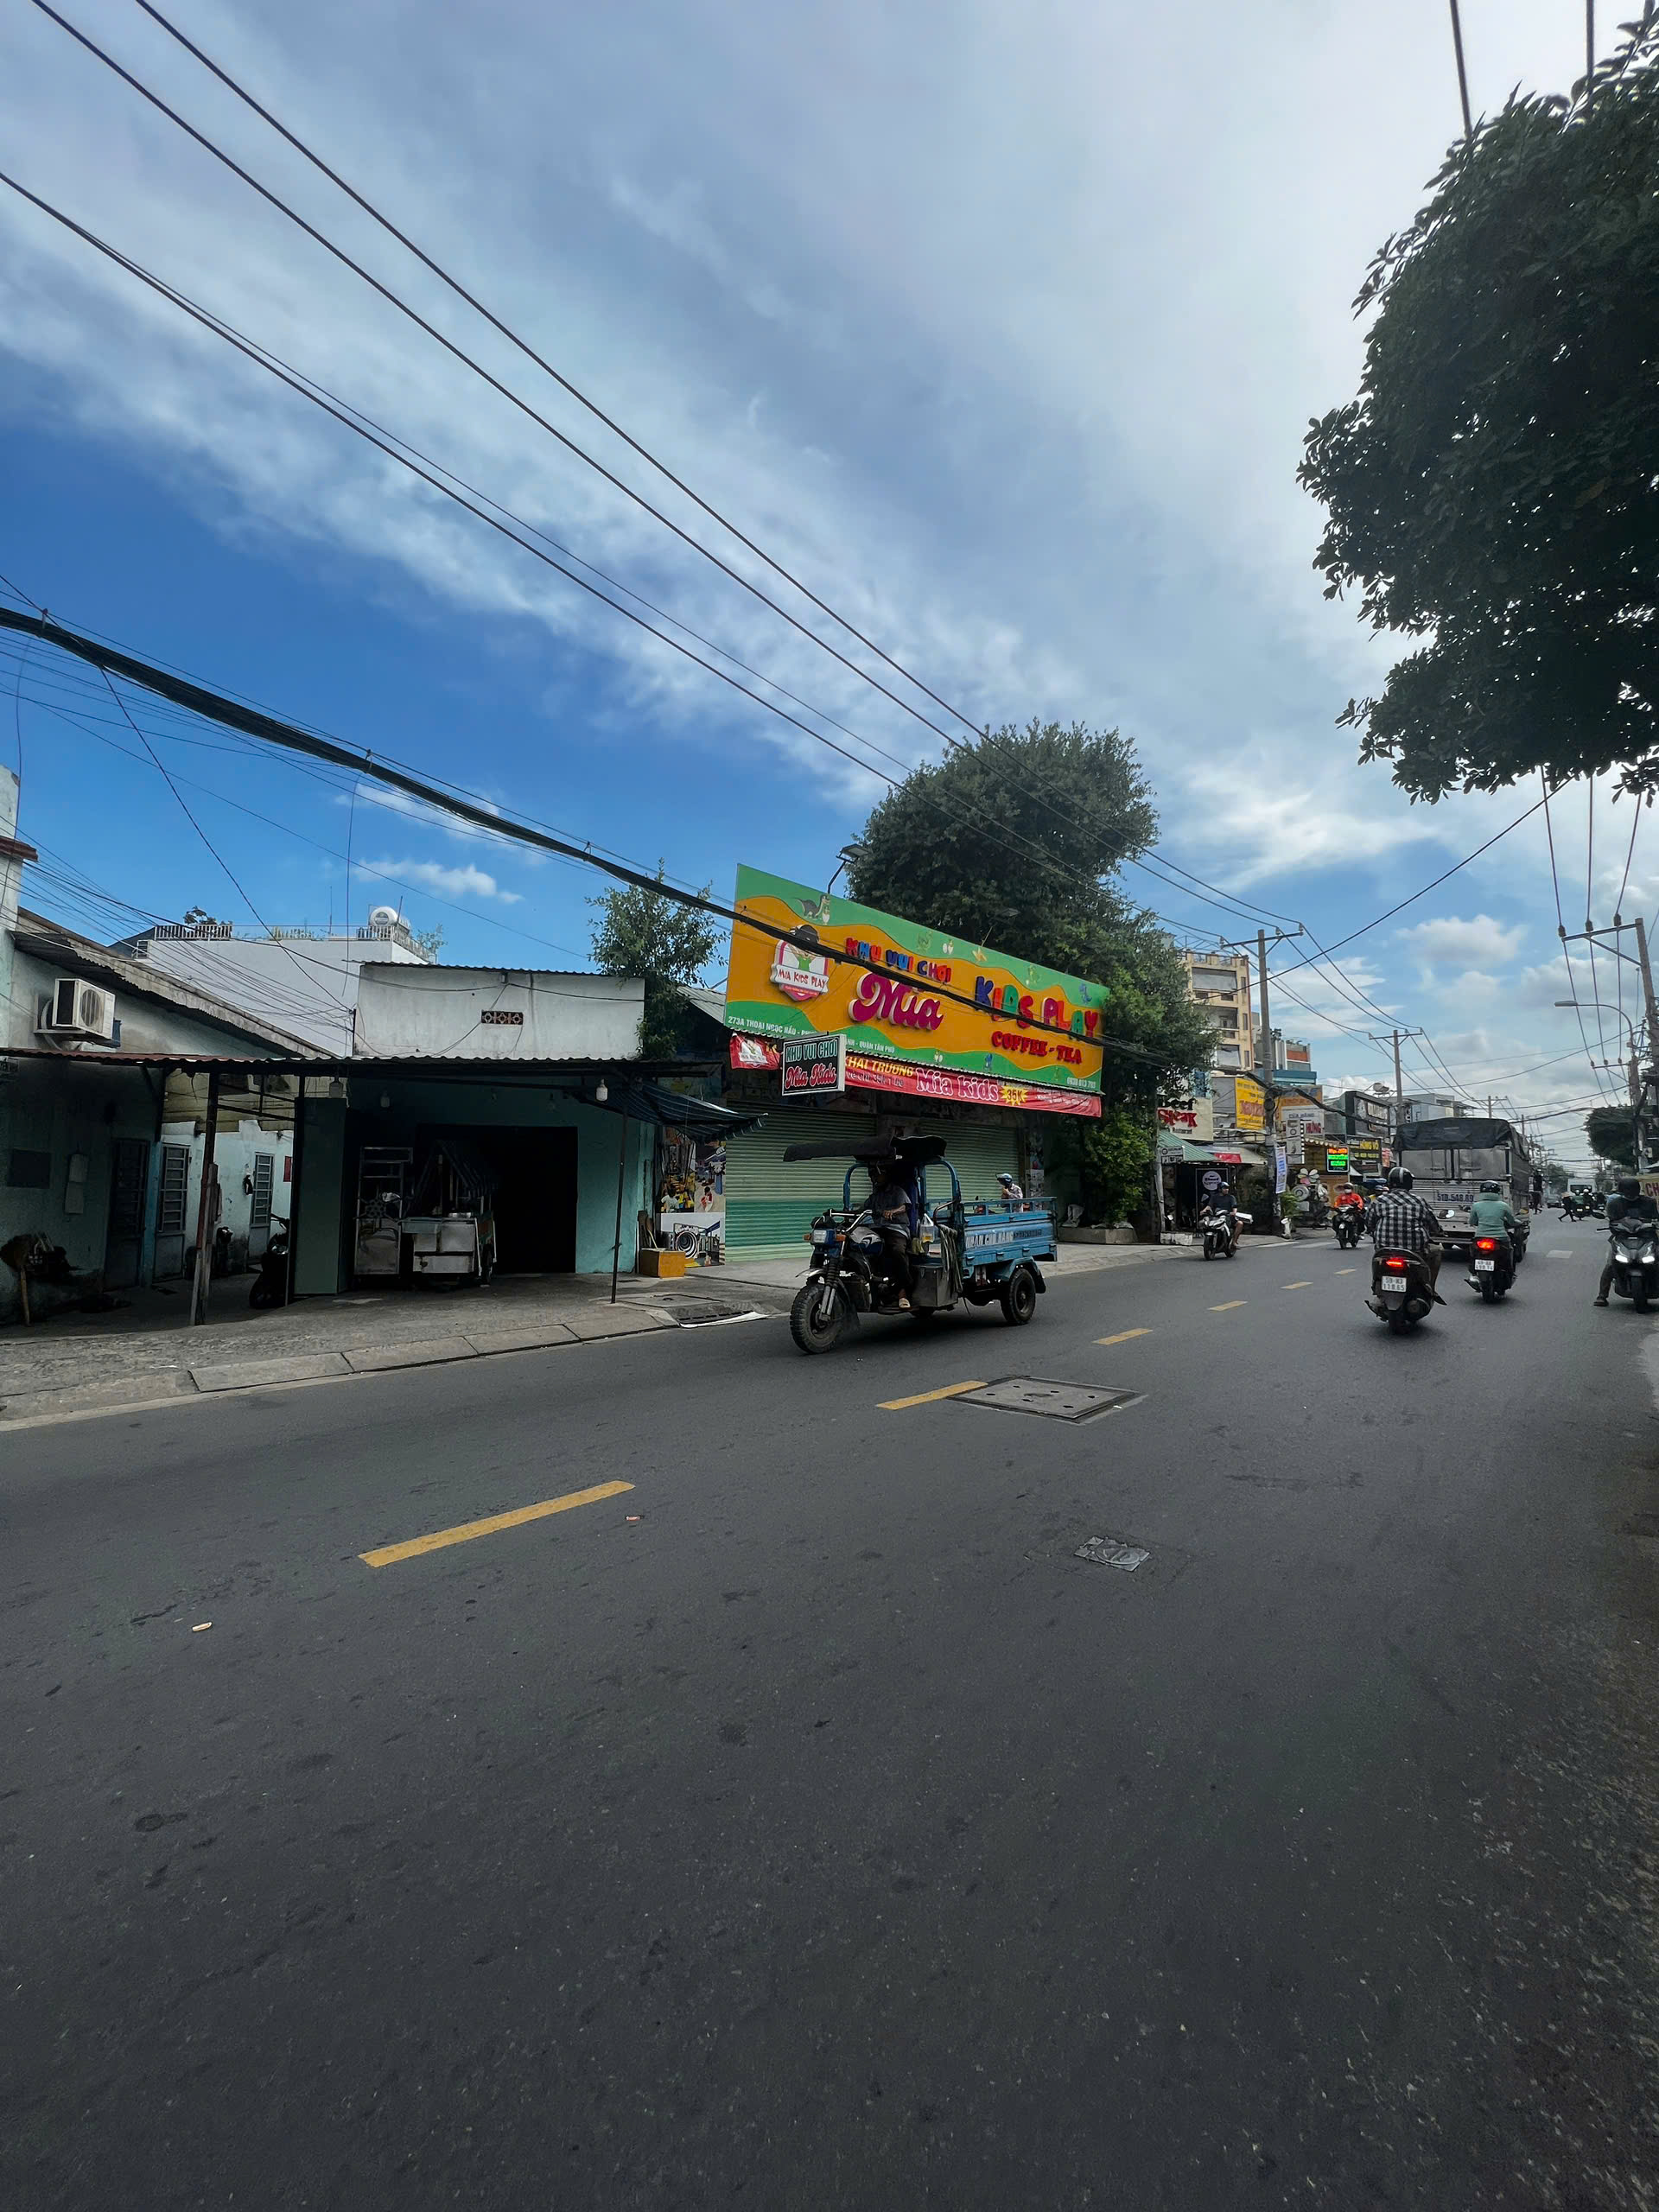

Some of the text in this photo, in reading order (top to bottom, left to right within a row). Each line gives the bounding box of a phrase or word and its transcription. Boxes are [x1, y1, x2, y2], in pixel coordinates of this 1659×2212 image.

[845, 938, 950, 982] KHU VUI CHƠI
[778, 969, 826, 988] MIA KIDS PLAY
[849, 971, 944, 1030] Mia
[975, 976, 1098, 1039] KIDS PLAY
[728, 1015, 745, 1027] 273A
[786, 1044, 804, 1063] KHU
[804, 1042, 817, 1061] VUI
[818, 1039, 838, 1058] CHƠI
[992, 1031, 1047, 1058] COFFEE
[1056, 1046, 1082, 1065] TEA
[785, 1062, 837, 1090] Mia Kids
[916, 1067, 954, 1096] Mia
[957, 1074, 1000, 1102] kids
[1007, 1089, 1023, 1102] 35K
